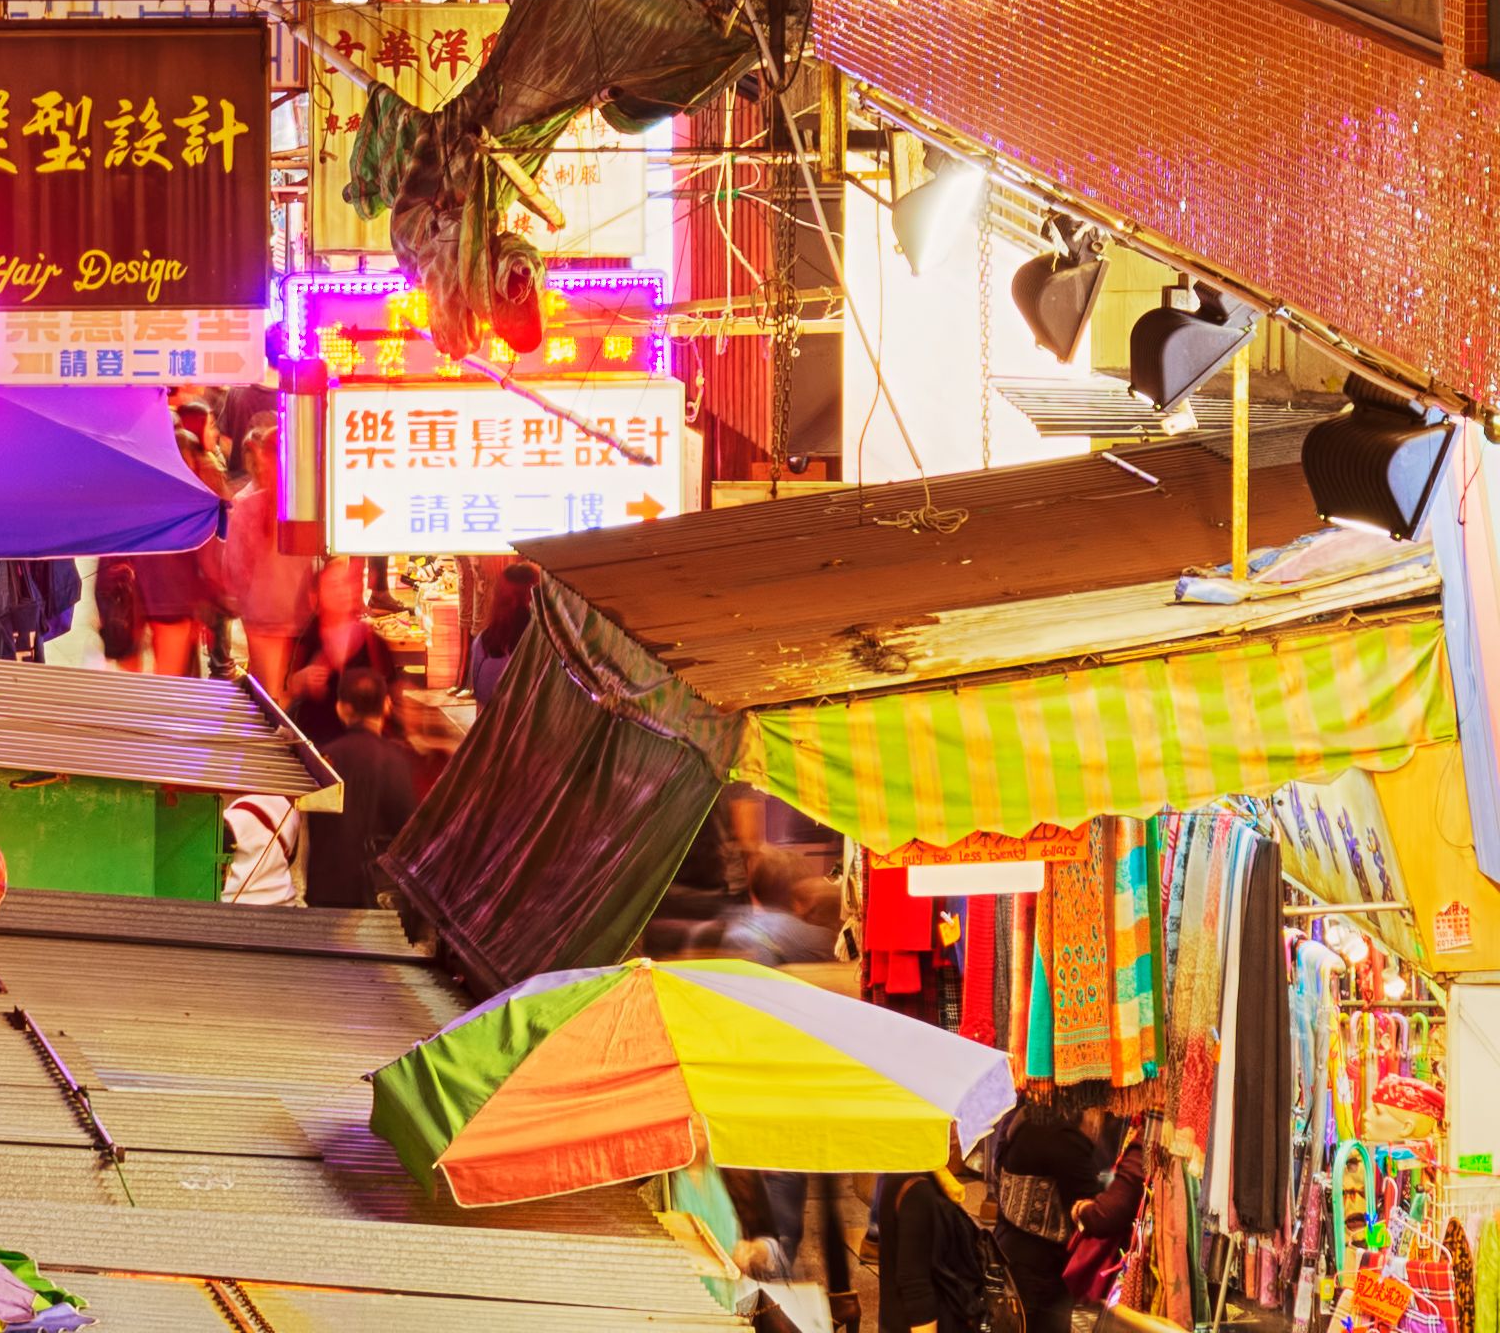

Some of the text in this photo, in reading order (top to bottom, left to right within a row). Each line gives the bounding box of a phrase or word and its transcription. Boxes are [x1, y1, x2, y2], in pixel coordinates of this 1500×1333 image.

[73, 248, 188, 304] Design
[59, 349, 198, 378] 請登二樓
[411, 493, 605, 534] 請登二樓
[932, 851, 952, 862] two
[1040, 844, 1078, 856] dollars
